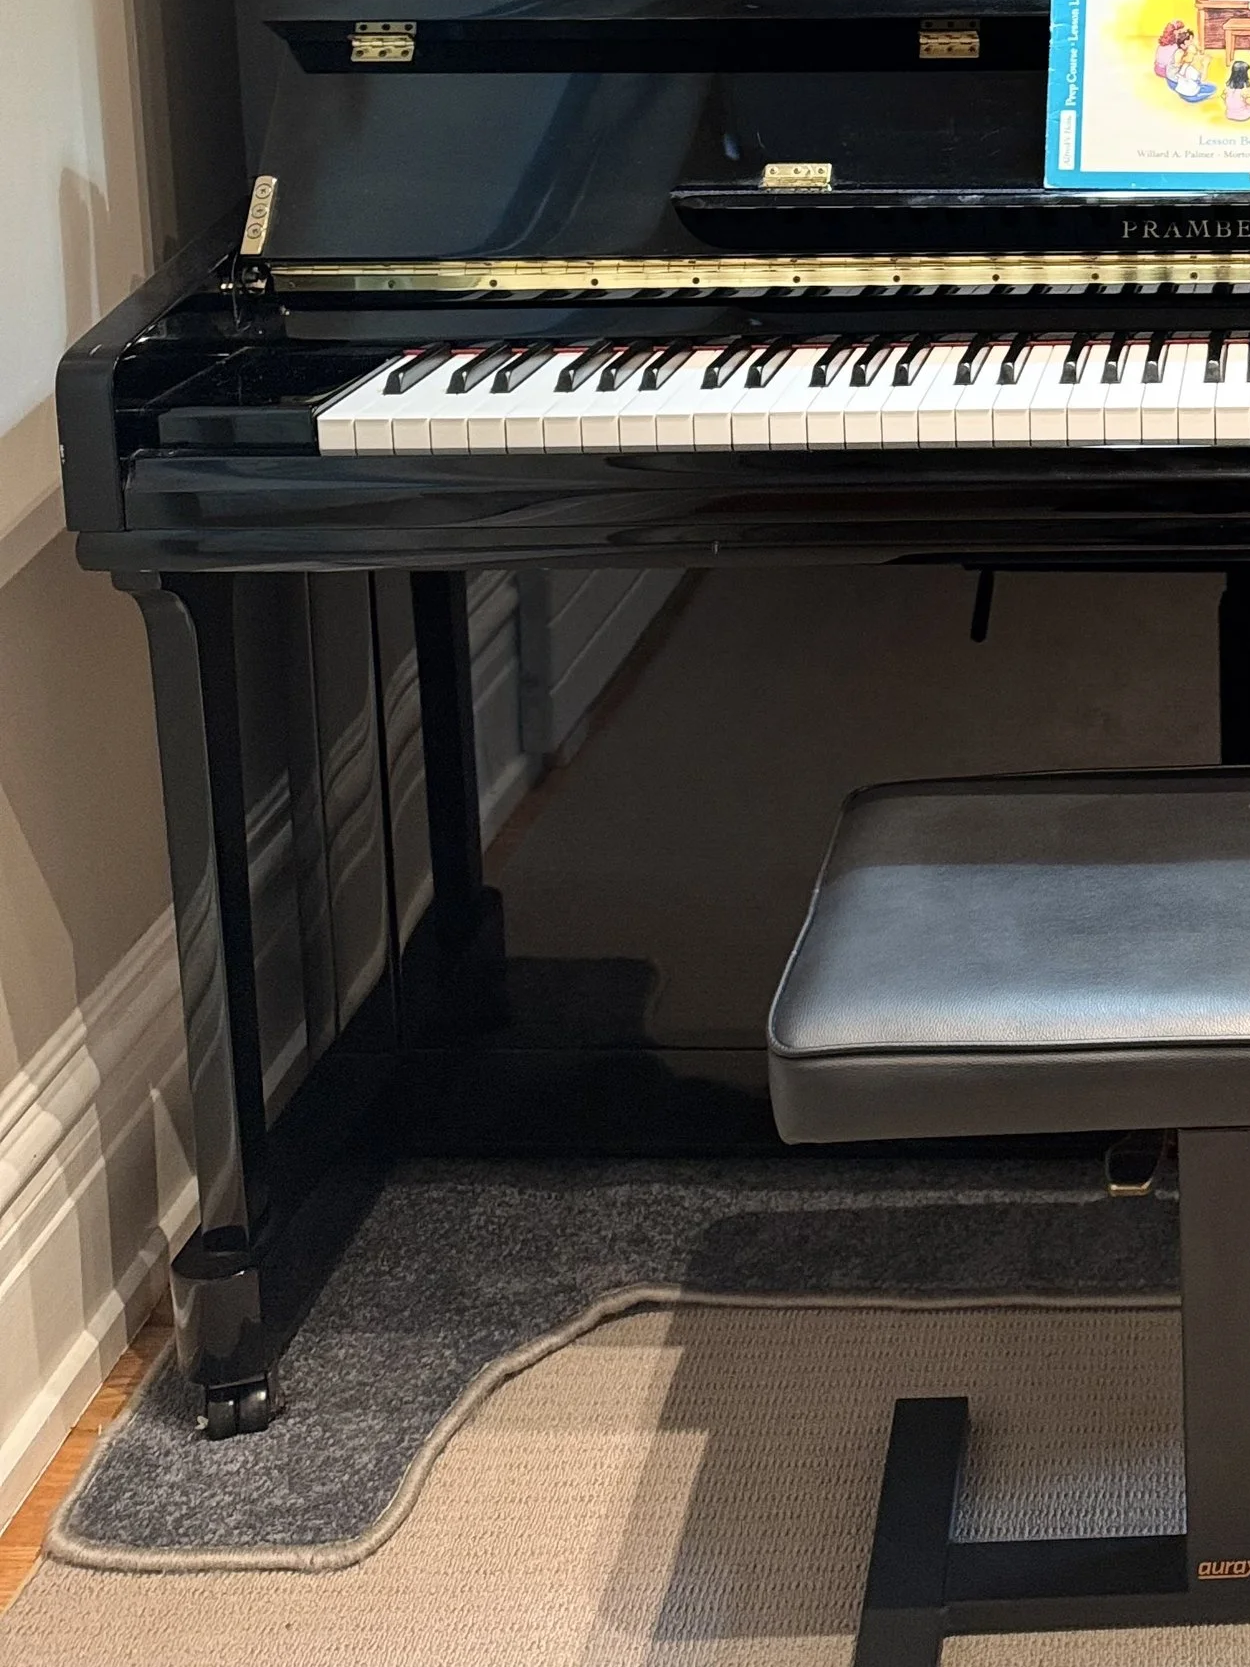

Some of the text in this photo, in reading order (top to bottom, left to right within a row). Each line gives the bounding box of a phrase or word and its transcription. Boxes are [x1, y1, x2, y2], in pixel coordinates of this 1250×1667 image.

[1067, 9, 1080, 41] Lesson
[1066, 48, 1079, 83] Course
[1064, 84, 1079, 106] Prep
[1198, 135, 1237, 146] Lesson
[1136, 149, 1170, 159] Willard
[1184, 150, 1215, 159] Palmer
